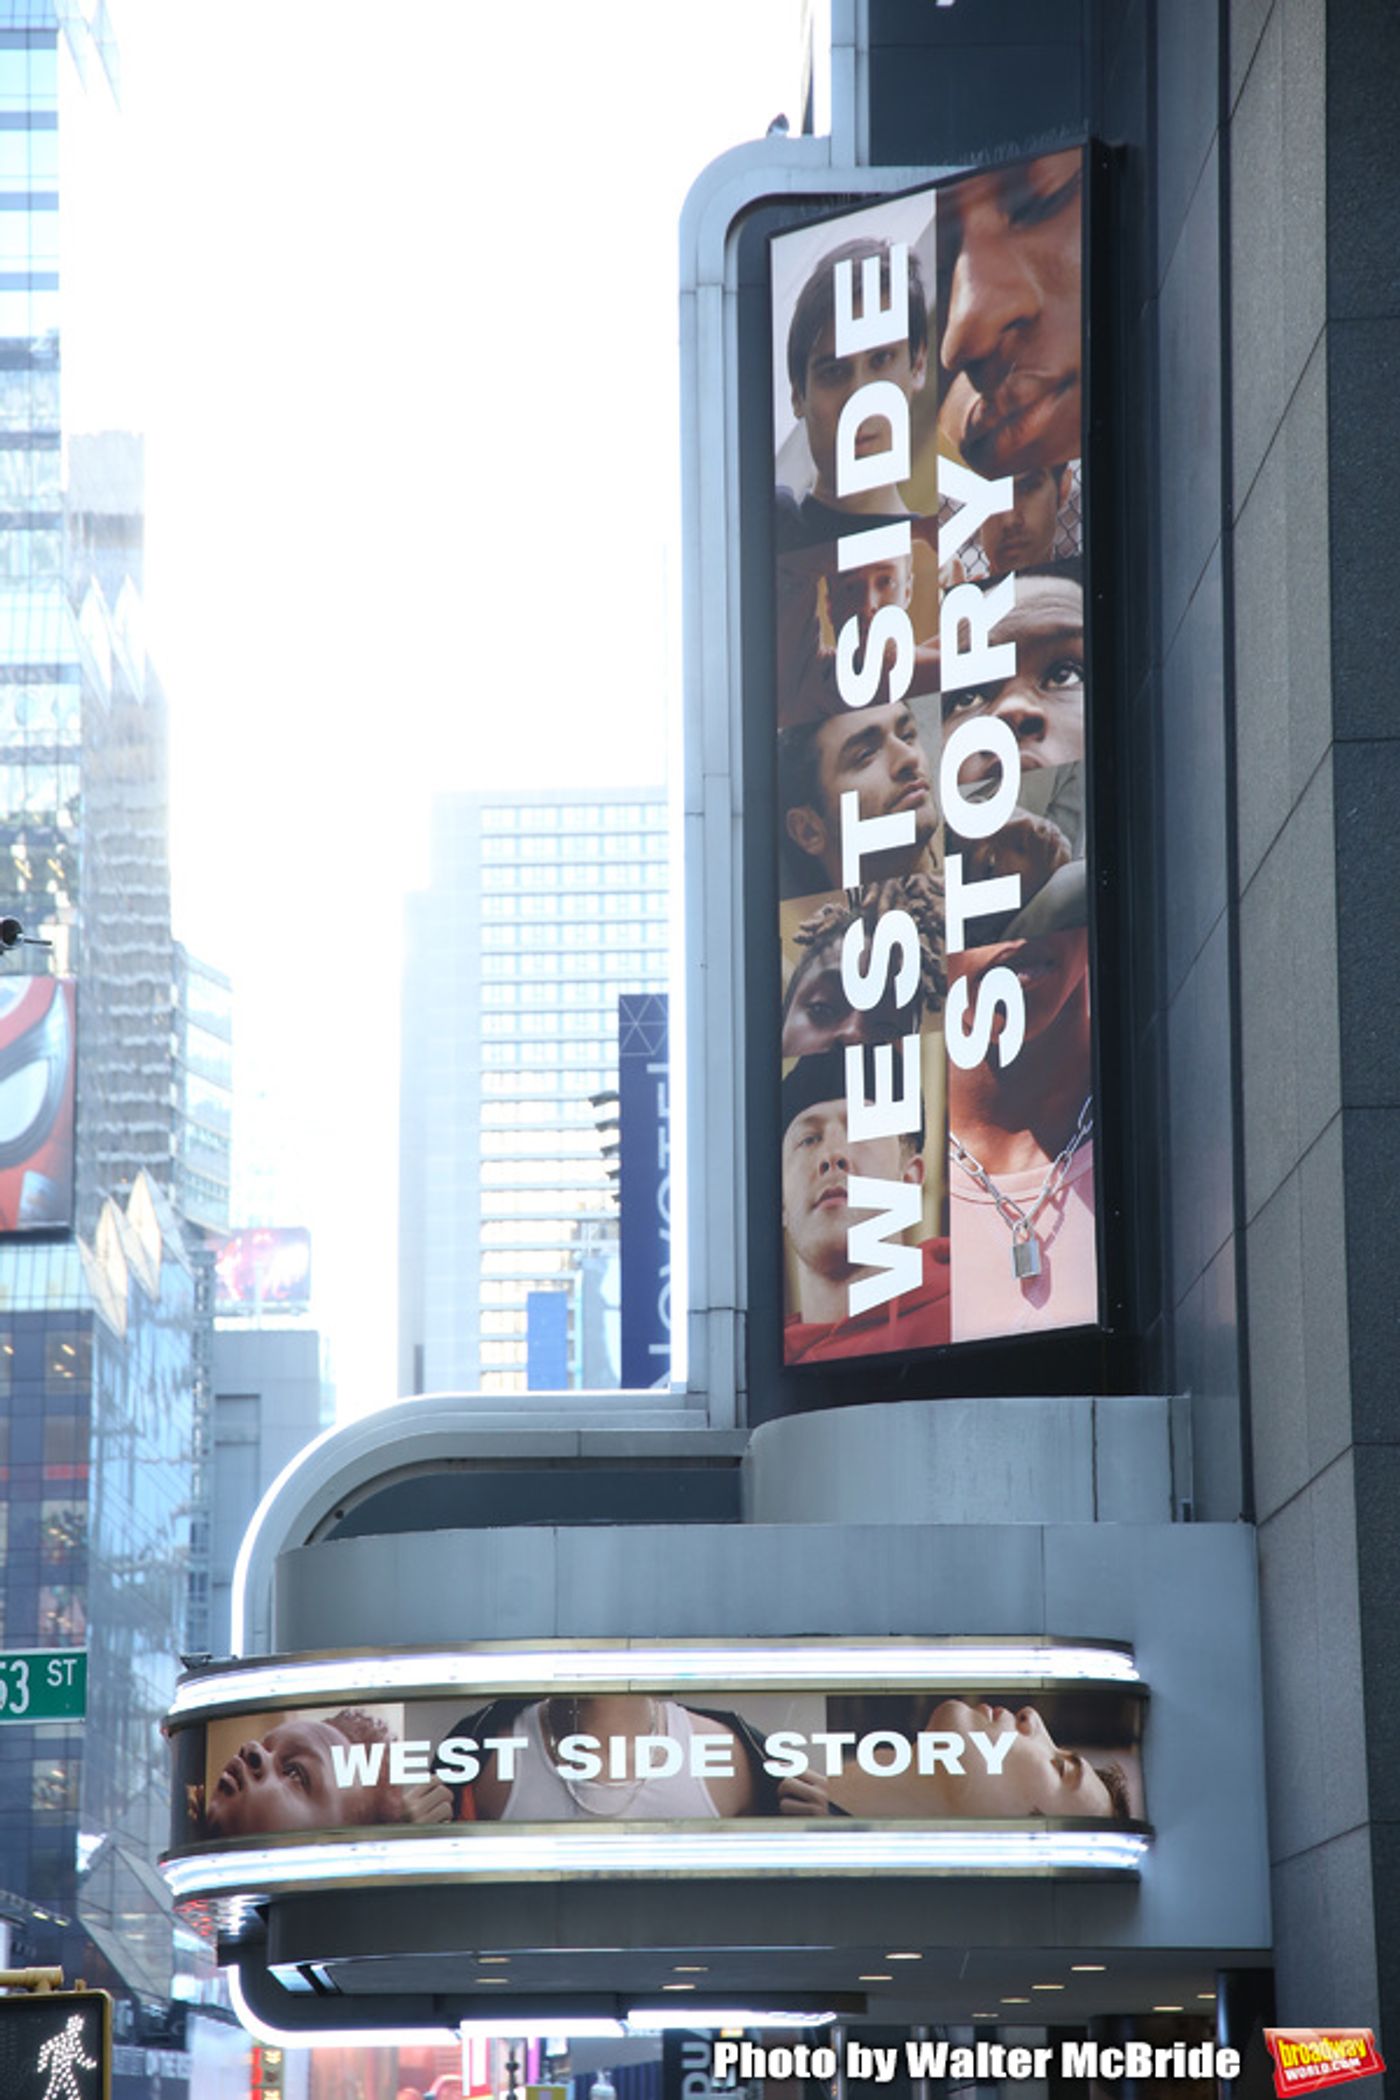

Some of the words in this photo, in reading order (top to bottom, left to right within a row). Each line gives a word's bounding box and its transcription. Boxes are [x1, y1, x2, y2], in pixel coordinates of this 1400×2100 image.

[833, 243, 914, 708] SIDE
[937, 454, 1026, 1071] STORY
[840, 790, 923, 1317] WEST
[46, 1658, 78, 1687] ST
[330, 1736, 528, 1789] WEST
[556, 1733, 735, 1782] SIDE
[762, 1731, 1019, 1778] STORY
